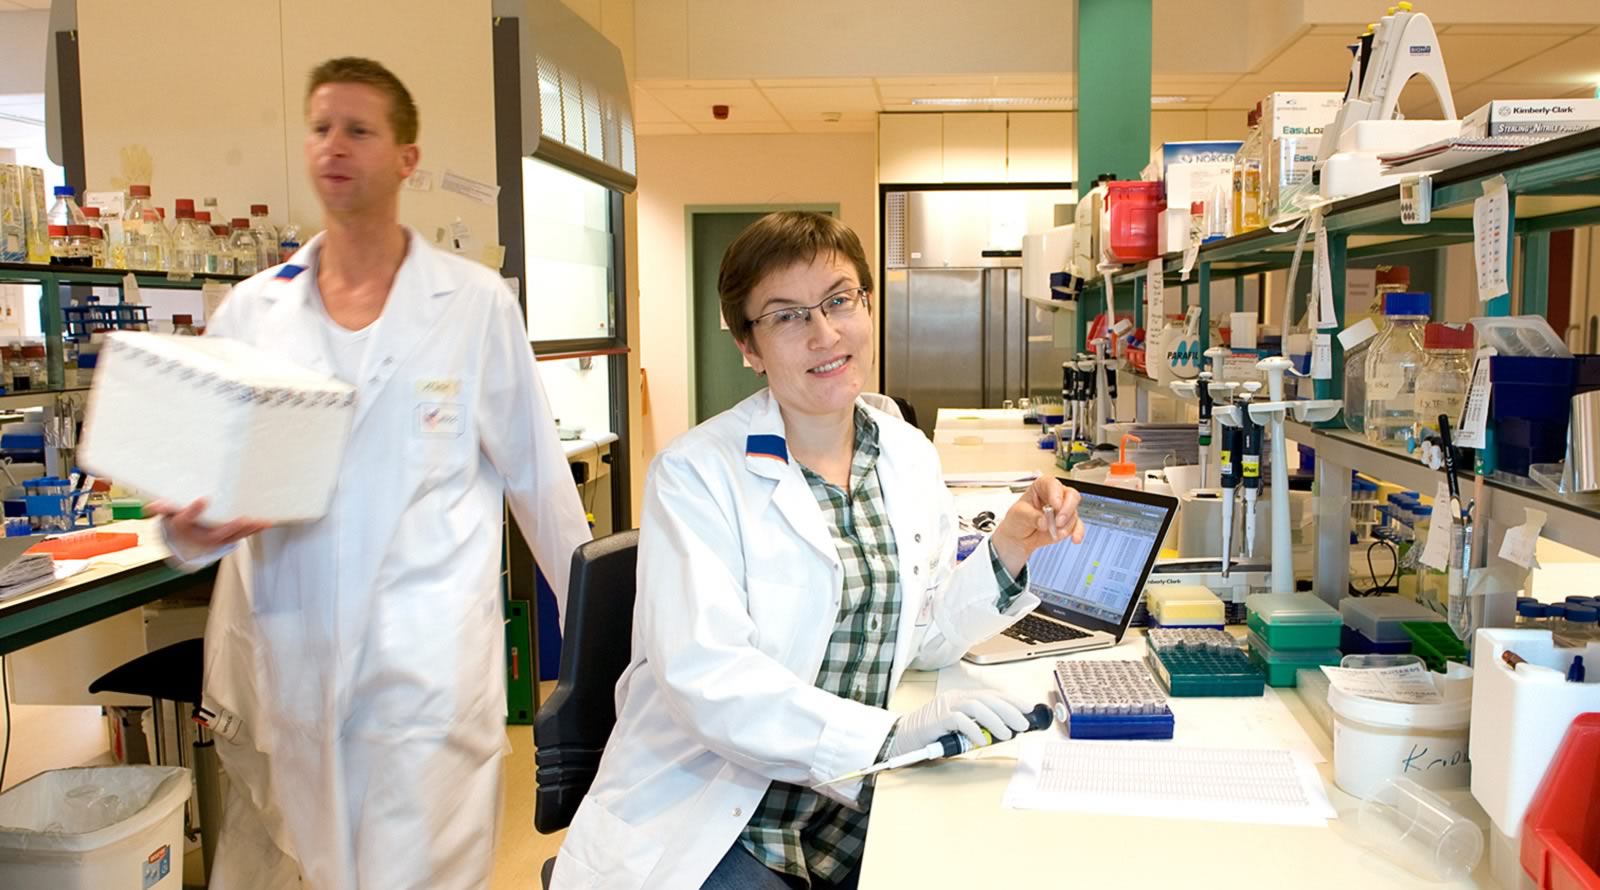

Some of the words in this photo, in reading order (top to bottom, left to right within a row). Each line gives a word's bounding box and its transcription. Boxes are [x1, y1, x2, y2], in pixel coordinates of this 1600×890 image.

[1513, 106, 1573, 115] Kimberly-Clark
[1282, 126, 1325, 136] EasyLoa
[1167, 351, 1199, 360] PARAFIL
[1147, 578, 1181, 586] mberly-Clark
